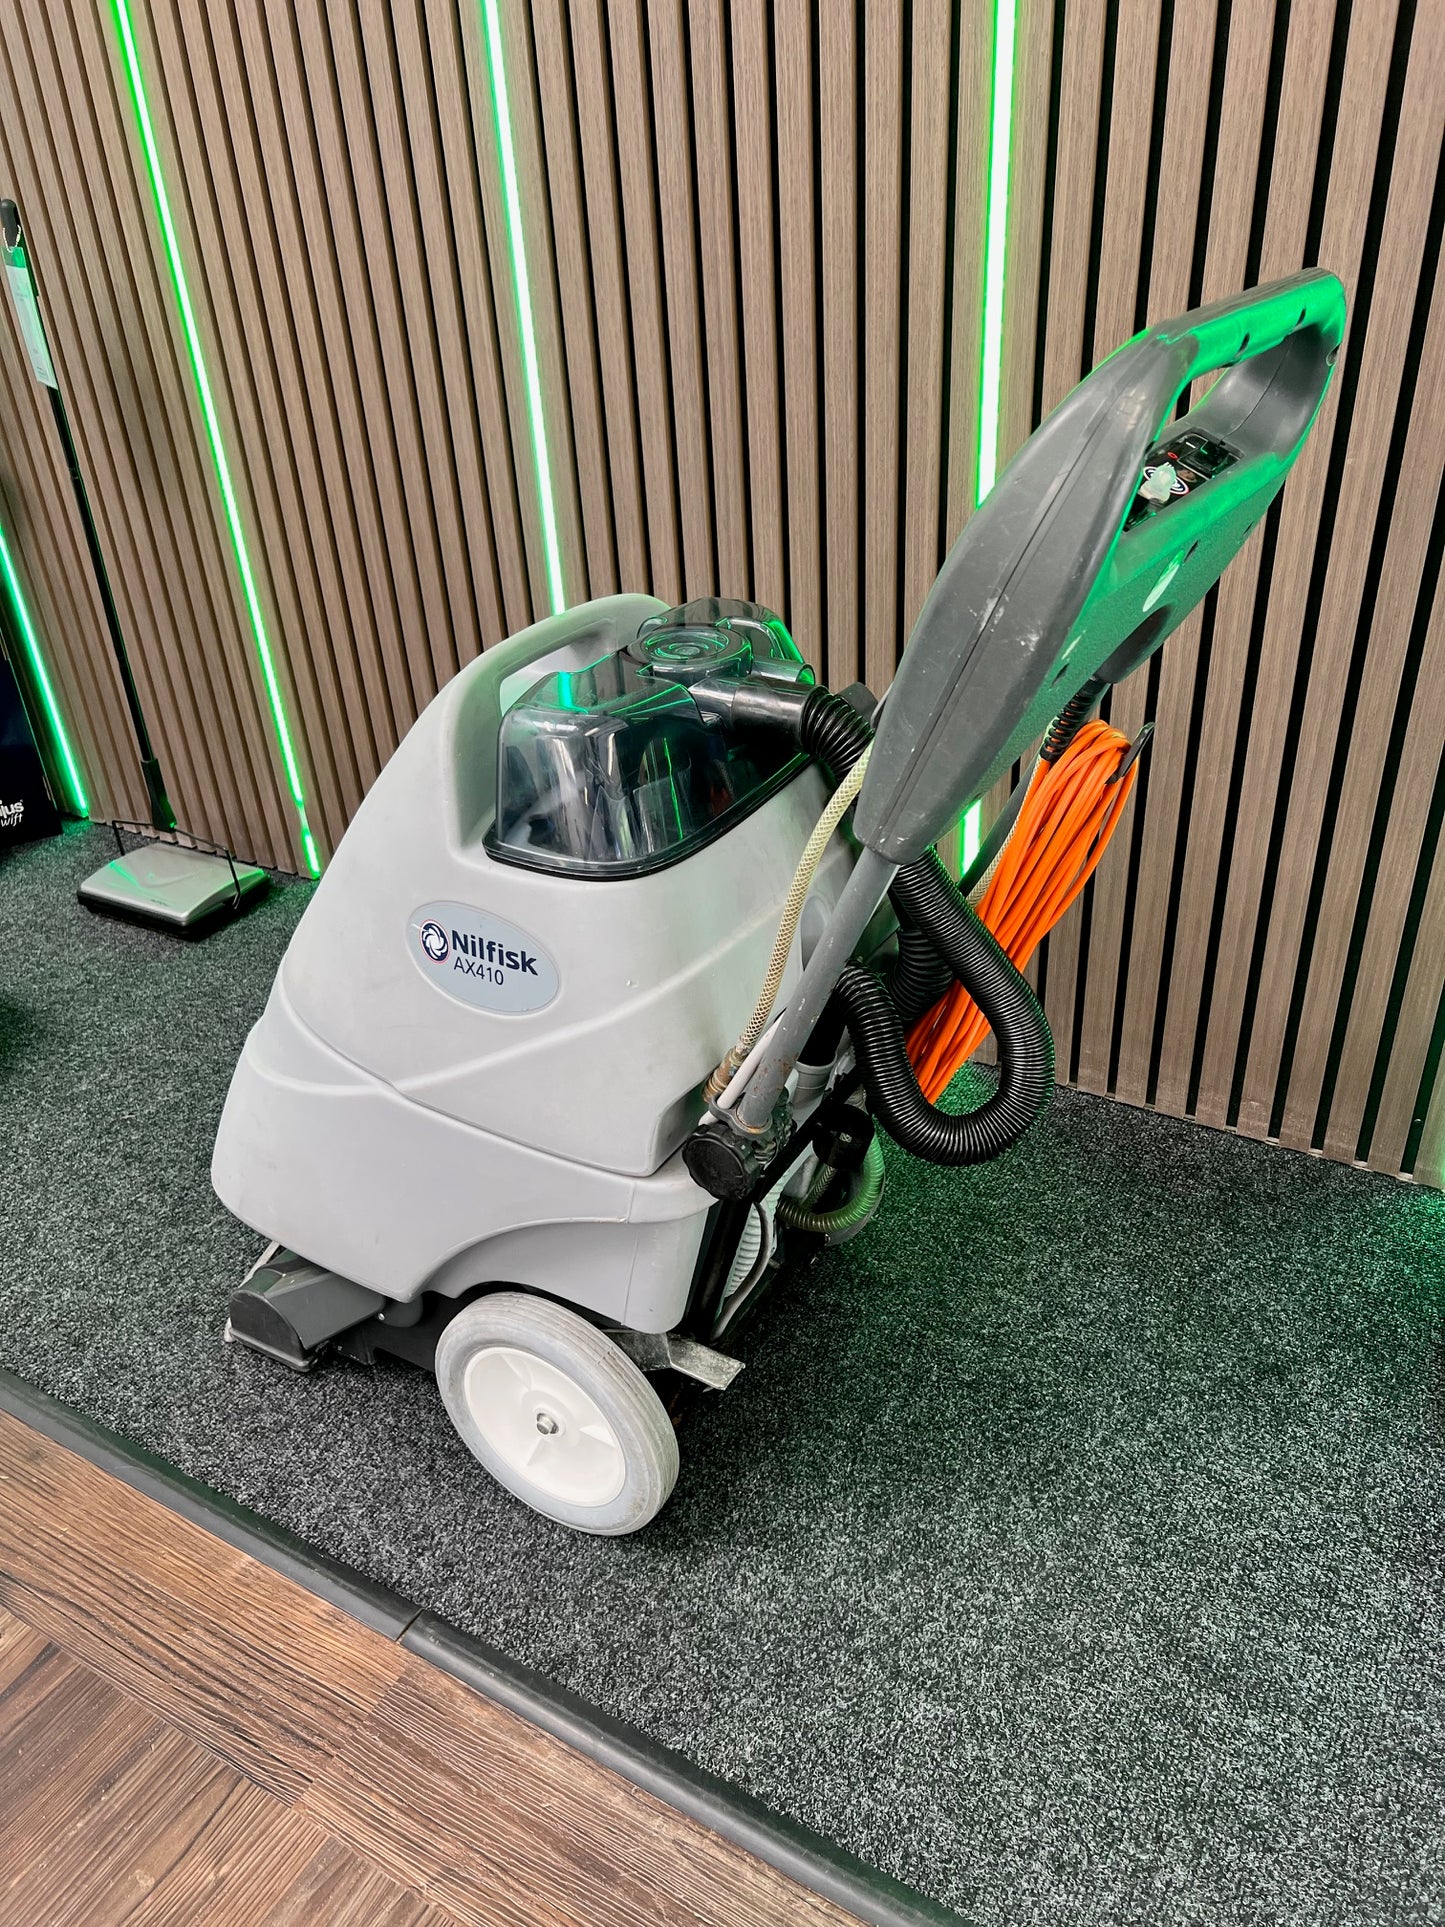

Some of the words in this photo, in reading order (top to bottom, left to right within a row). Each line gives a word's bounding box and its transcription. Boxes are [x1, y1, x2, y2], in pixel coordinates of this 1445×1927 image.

[0, 799, 24, 819] ius
[451, 929, 538, 976] Nilfisk
[453, 956, 504, 985] AX410
